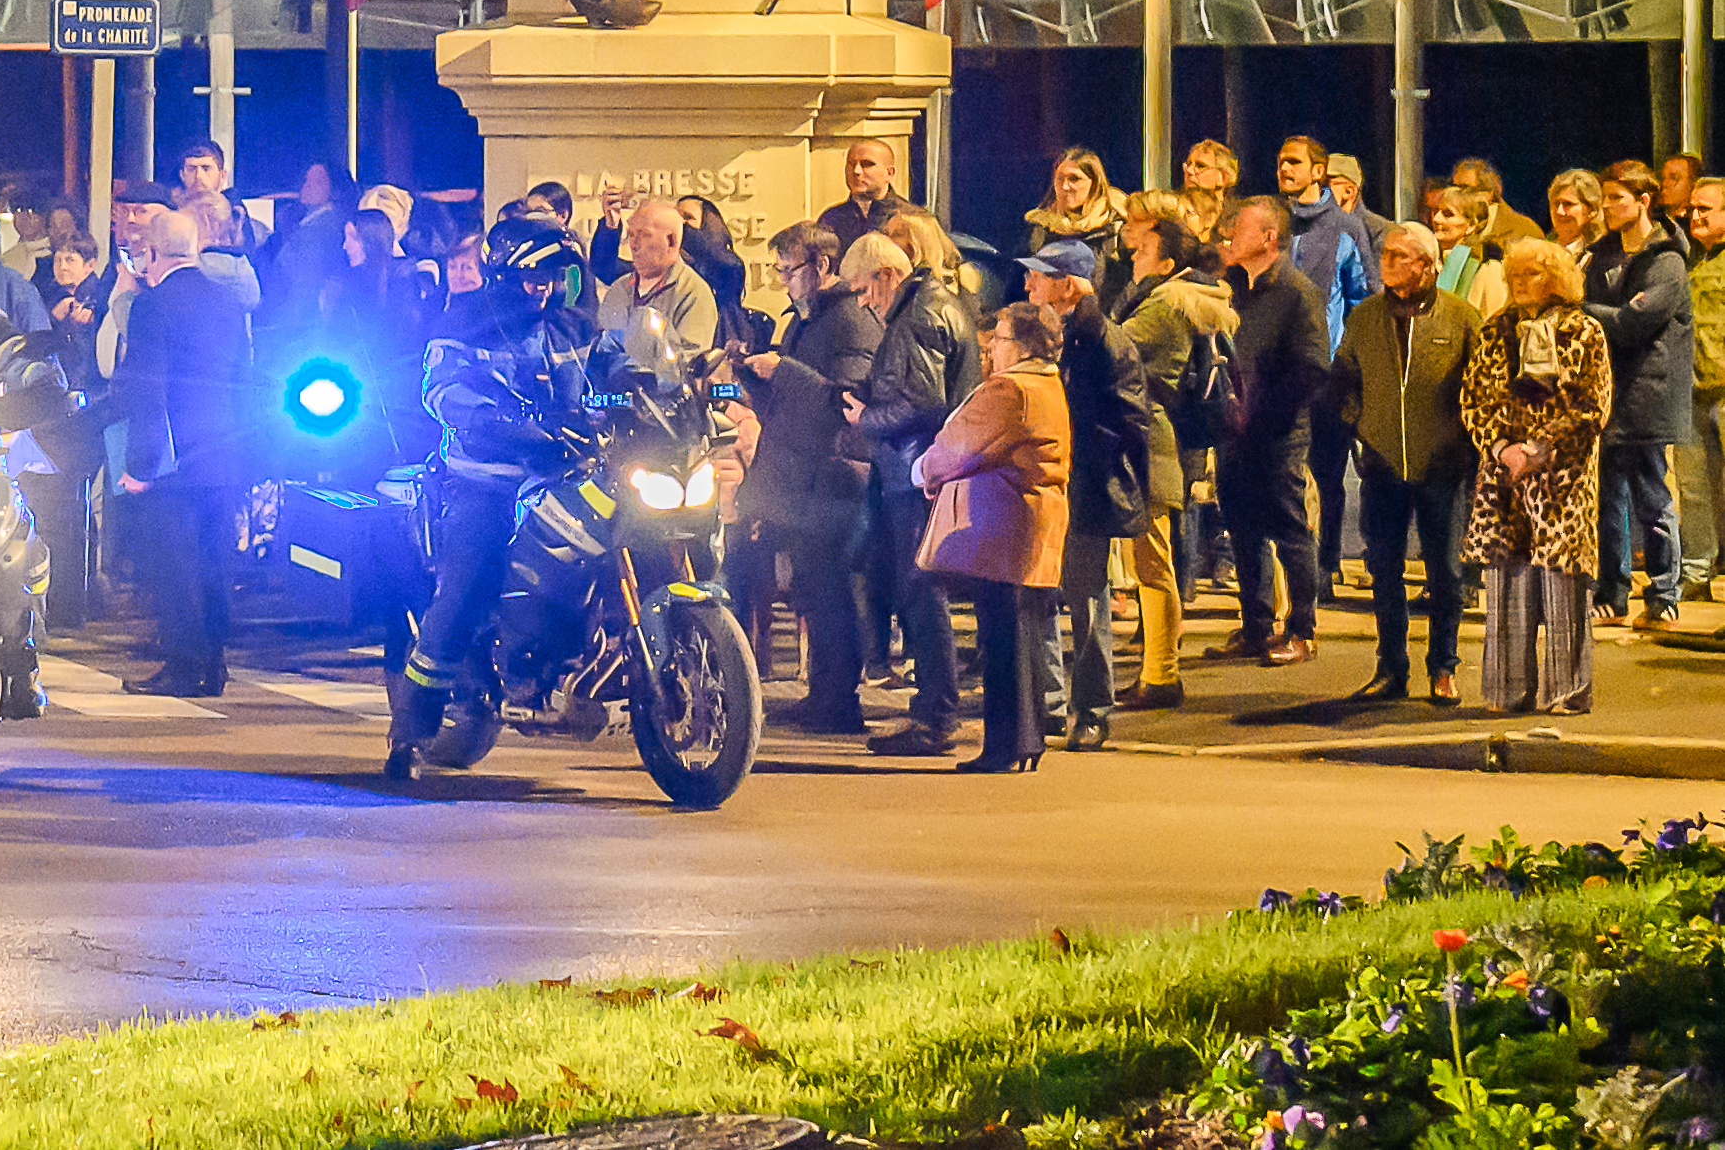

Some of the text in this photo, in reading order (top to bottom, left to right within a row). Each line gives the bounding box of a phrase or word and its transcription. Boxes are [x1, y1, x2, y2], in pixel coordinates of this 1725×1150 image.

[78, 6, 153, 23] PROMENADE
[64, 26, 149, 45] de la CHARITÉ
[576, 168, 757, 198] LA BRESSE
